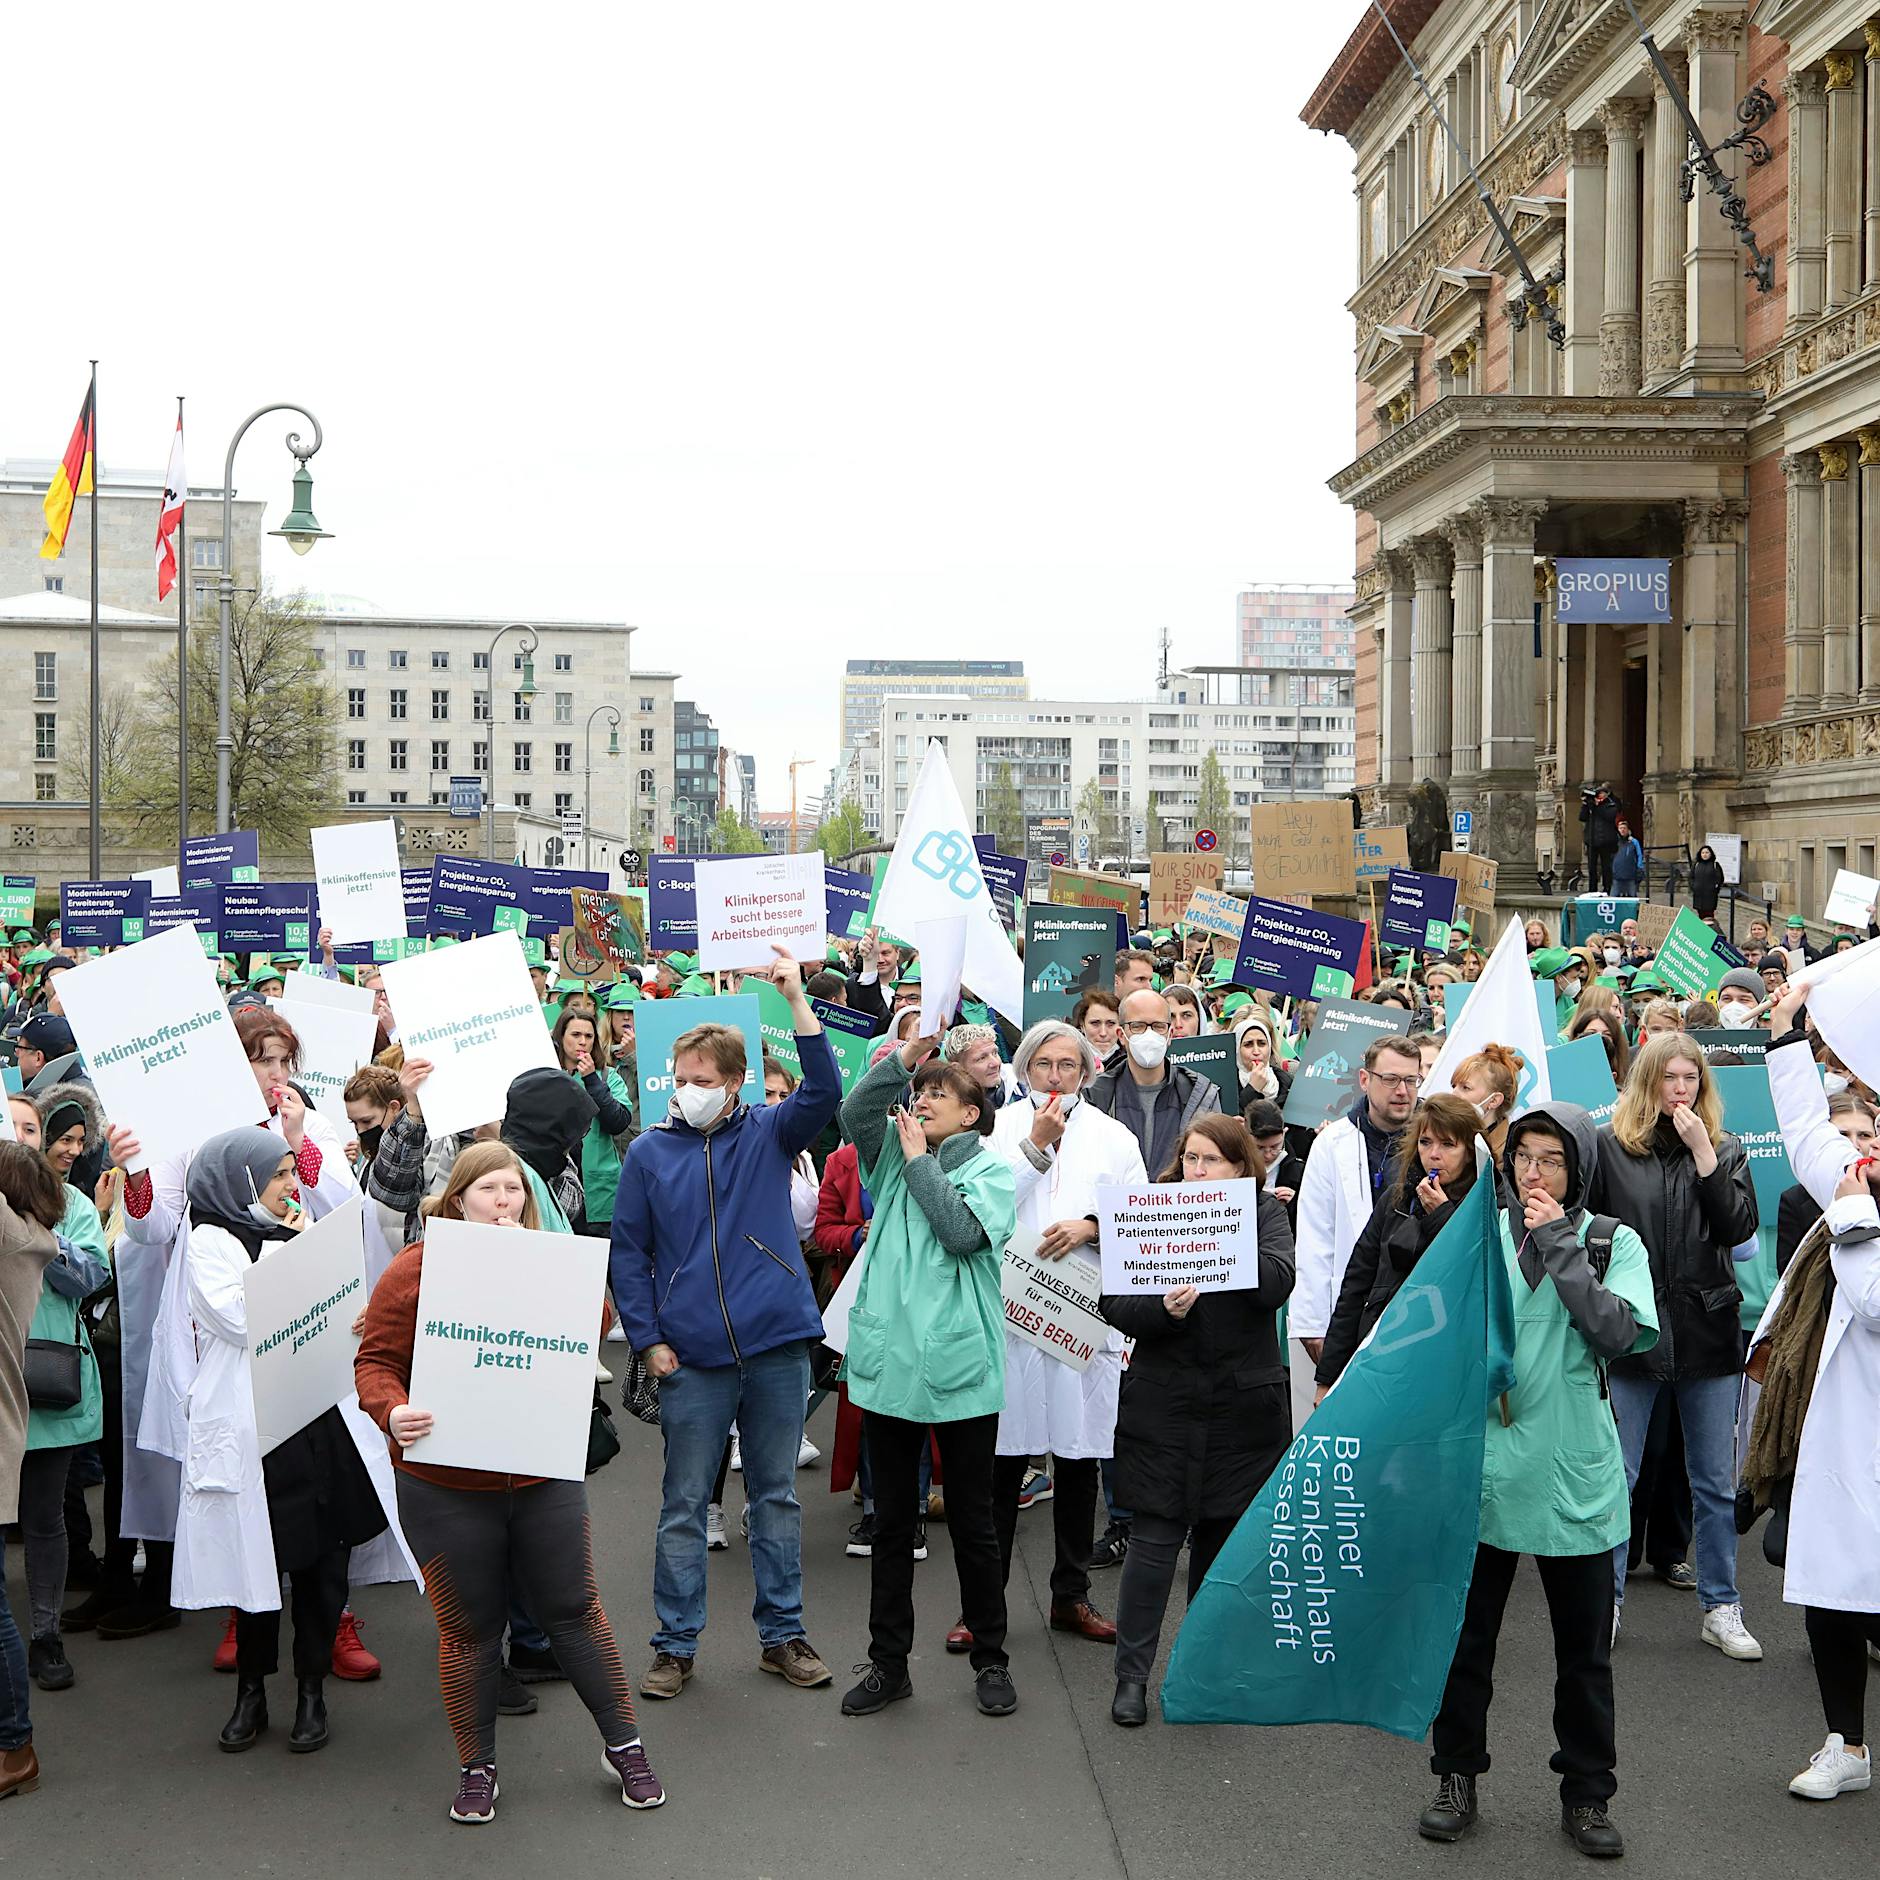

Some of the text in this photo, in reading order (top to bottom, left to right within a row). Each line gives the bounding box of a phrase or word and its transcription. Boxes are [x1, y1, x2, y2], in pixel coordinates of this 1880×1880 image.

[1557, 572, 1668, 593] GROPIUS
[1557, 591, 1668, 612] BAU
[1456, 815, 1467, 831] P
[186, 845, 234, 857] Modernisierung
[186, 854, 231, 866] Intensivstation
[320, 868, 398, 885] #klinikoffensive
[440, 868, 476, 882] Projekte
[474, 875, 490, 885] zur
[1153, 862, 1179, 878] WIR
[67, 888, 132, 898] Modernisierung/
[346, 881, 374, 896] jetzt!
[438, 879, 517, 901] Energieeinsparung
[1175, 878, 1193, 892] ES
[1391, 882, 1423, 897] Erneuerung
[7, 895, 31, 904] EURO
[67, 899, 115, 909] Erweiterung
[225, 896, 259, 905] Neubau
[580, 891, 609, 907] mehr
[725, 888, 806, 908] Klinikpersonal
[1162, 892, 1192, 916] WE
[1195, 891, 1217, 904] mehr
[1389, 893, 1424, 909] Angioanlage
[0, 907, 18, 918] ZT!
[67, 908, 124, 917] Intensivstation
[149, 908, 200, 918] Modernisierung
[225, 906, 309, 916] Krankenpflegeschul
[503, 911, 512, 920] 2
[730, 907, 803, 924] sucht bessere
[128, 921, 140, 930] 10
[149, 916, 211, 927] Endoskopiezentrum
[496, 919, 509, 928] Mio
[1033, 920, 1108, 931] #klinikoffensive
[1253, 914, 1295, 933] Projekte
[1295, 926, 1312, 937] zur
[287, 926, 309, 937] 10,5
[711, 921, 817, 942] Arbeitsbedingungen!
[1032, 930, 1060, 942] jetzt!
[1429, 924, 1442, 937] 0,9
[608, 943, 637, 960] mehr
[1251, 927, 1342, 960] Energieeinsparung
[1674, 926, 1709, 960] Verzerrter
[375, 948, 389, 956] Mio
[1668, 937, 1710, 977] Wettbewerb
[1326, 972, 1332, 983] 1
[1663, 950, 1708, 990] durch unfaire
[1315, 984, 1339, 995] Mio €
[407, 1000, 535, 1048] #klinikoffensive
[826, 1014, 855, 1028] Diakonie
[827, 1009, 871, 1028] Johannesstift
[1320, 1019, 1349, 1032] jetzt!
[1325, 1010, 1399, 1031] #klinikoffensive
[92, 1007, 223, 1069] #klinikoffensive
[453, 1027, 498, 1054] jetzt!
[1169, 1048, 1227, 1065] ikoffensive
[1698, 1043, 1767, 1054] klinikoffens
[140, 1041, 188, 1074] jetzt!
[303, 1084, 326, 1098] tzt!
[1746, 1145, 1783, 1161] jetzt!
[1128, 1190, 1228, 1207] Politik fordert:
[1113, 1207, 1242, 1224] Mindestmengen in der
[1116, 1221, 1241, 1239] Patientenversorgung!
[1139, 1240, 1221, 1256] Wir fordern:
[1003, 1248, 1033, 1273] ETZT
[1123, 1255, 1236, 1272] Mindestmengen bei
[1131, 1271, 1230, 1288] der Finanzierung!
[1025, 1285, 1063, 1315] für ein
[255, 1276, 361, 1358] #klinikoffensive
[291, 1315, 330, 1356] jetzt!
[1004, 1294, 1043, 1331] NDES
[1042, 1322, 1094, 1362] BERLIN
[424, 1320, 590, 1355] #klinikoffensive
[474, 1347, 533, 1371] jetzt!
[1333, 1435, 1366, 1578] Berliner
[1268, 1433, 1309, 1651] Gesellschaft
[1301, 1434, 1337, 1665] Krankenhaus
